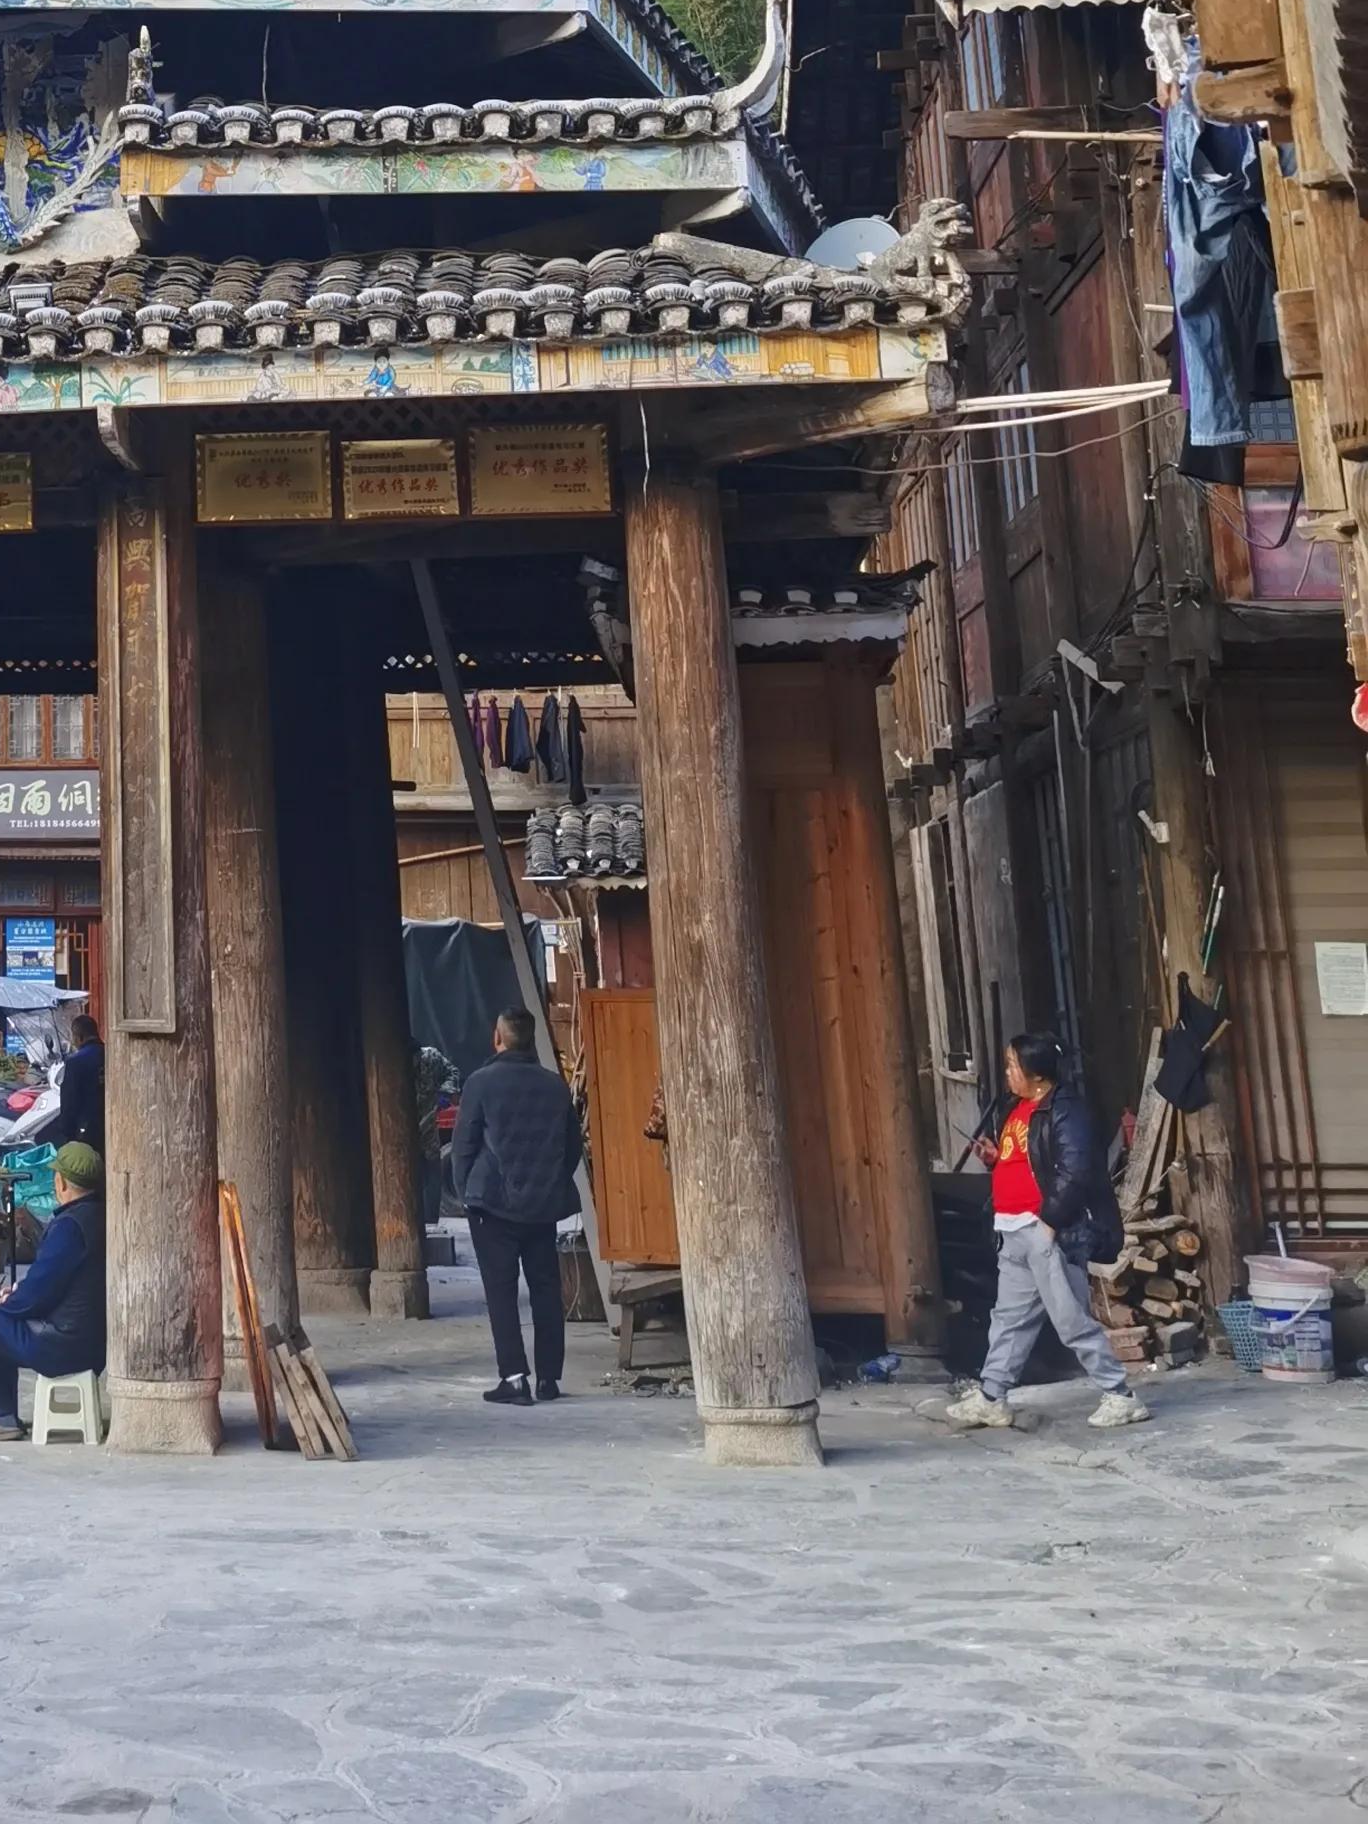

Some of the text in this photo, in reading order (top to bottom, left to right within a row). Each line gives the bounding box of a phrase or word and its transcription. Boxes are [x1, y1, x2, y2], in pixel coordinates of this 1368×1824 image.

[492, 456, 589, 477] 优秀作品奖
[358, 477, 439, 495] 优秀作品奖
